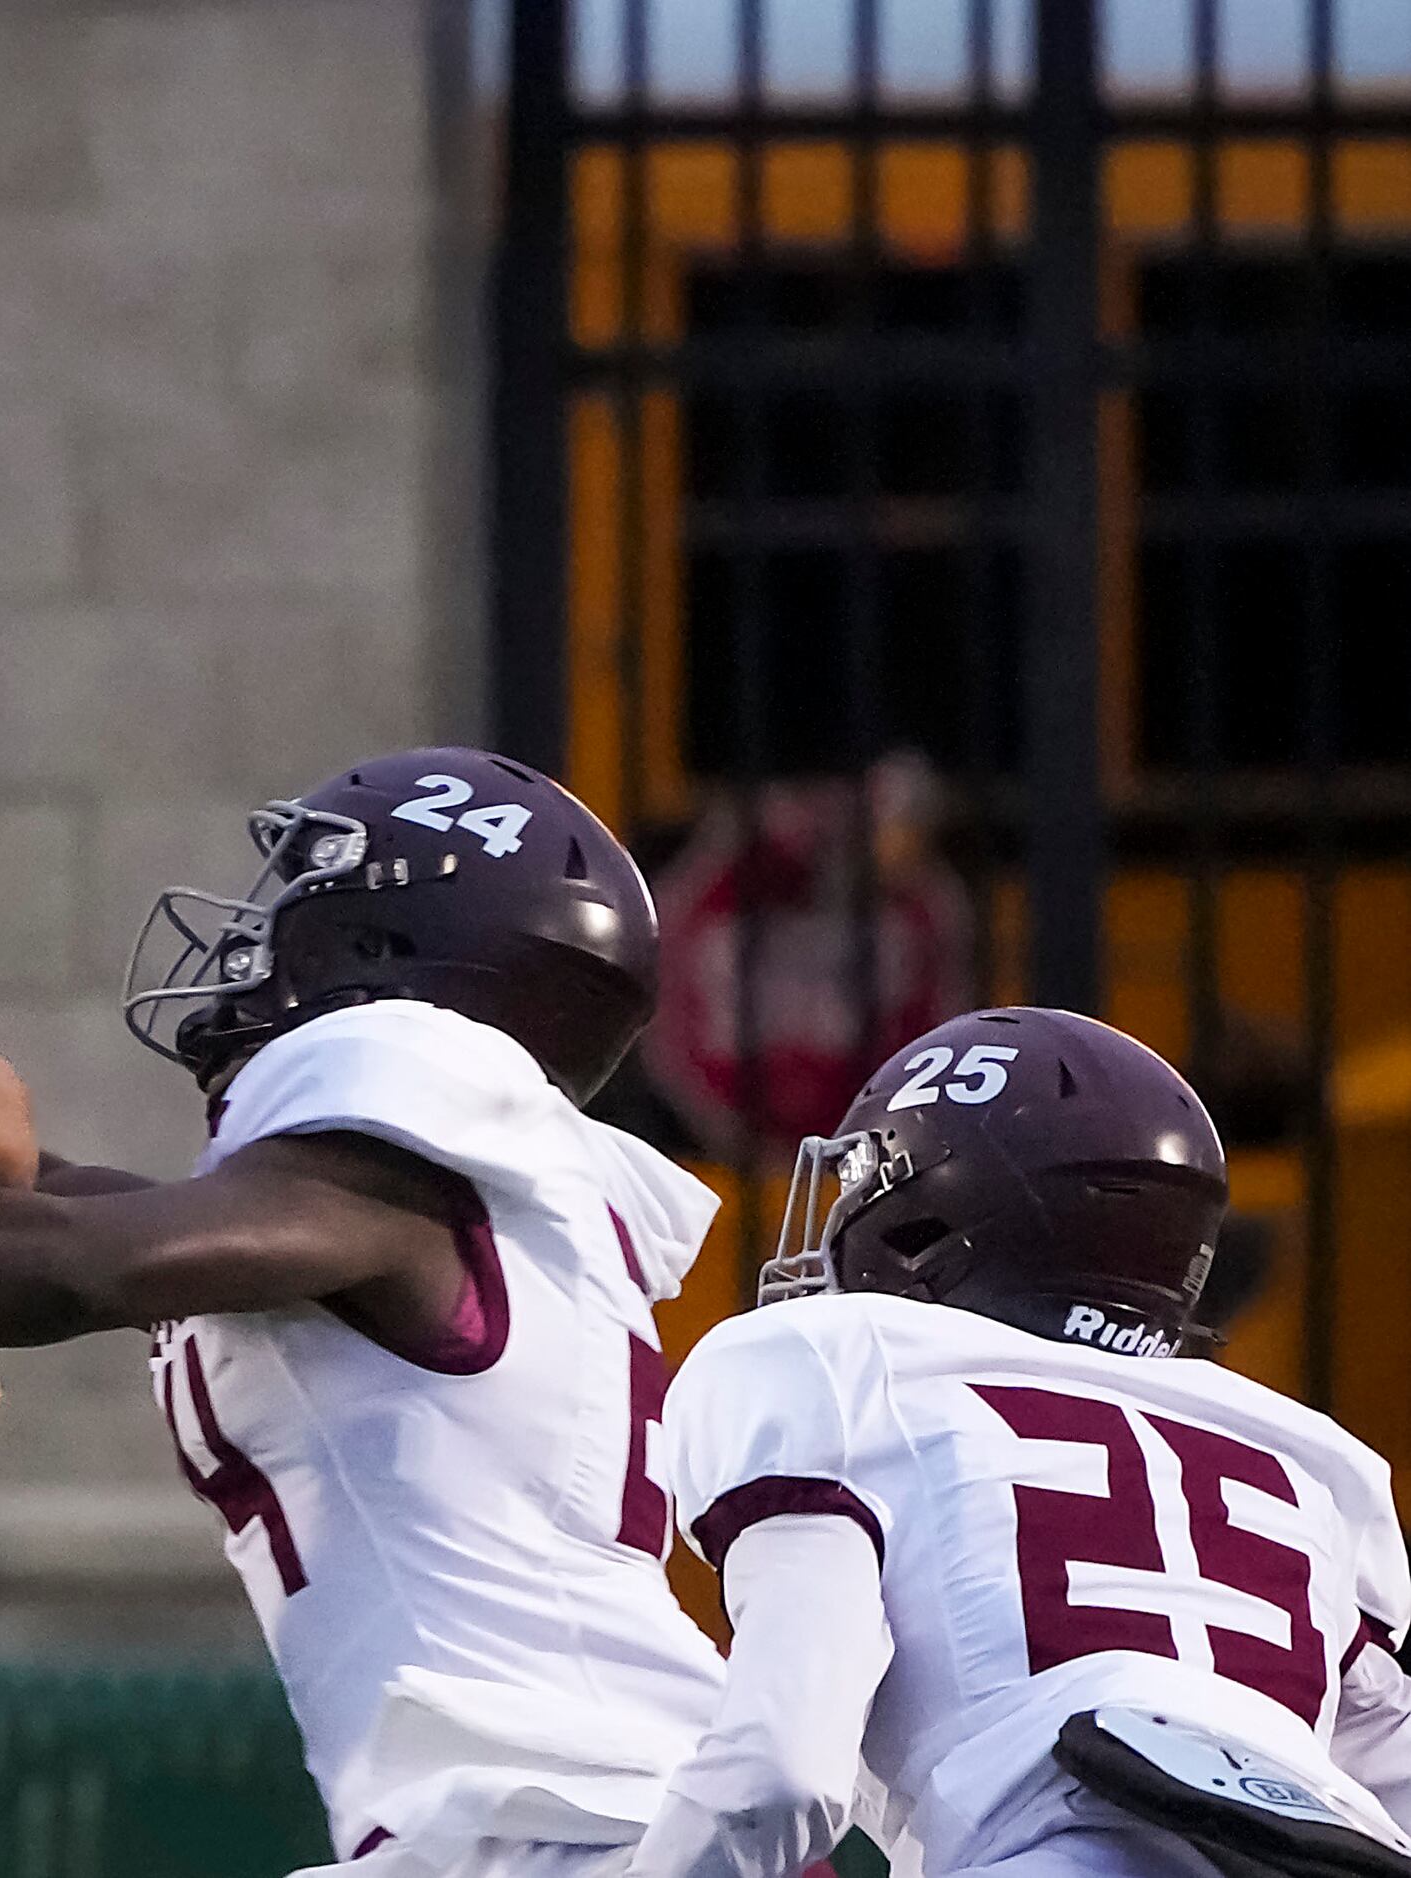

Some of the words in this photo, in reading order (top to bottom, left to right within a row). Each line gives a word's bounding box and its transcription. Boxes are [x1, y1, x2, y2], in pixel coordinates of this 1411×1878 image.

[391, 774, 533, 858] 24
[886, 1045, 1019, 1112] 25
[962, 1381, 1328, 1733] 25
